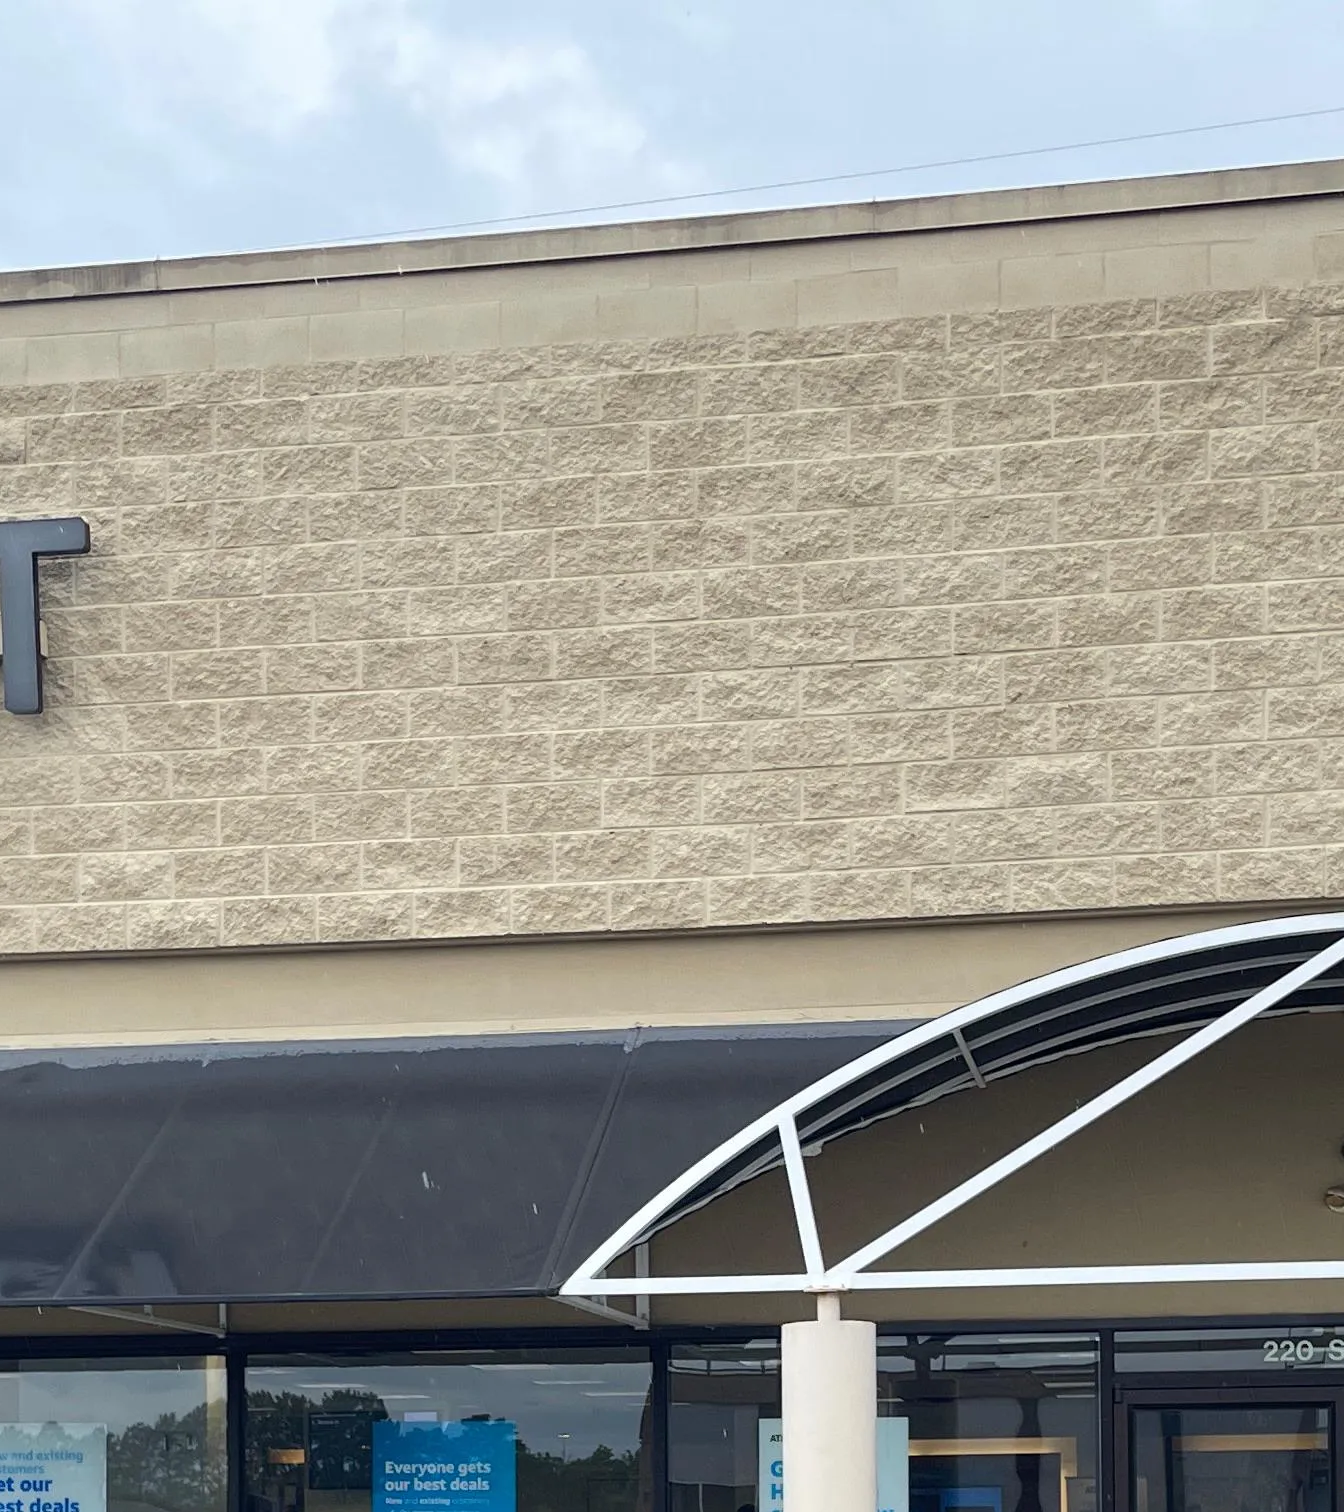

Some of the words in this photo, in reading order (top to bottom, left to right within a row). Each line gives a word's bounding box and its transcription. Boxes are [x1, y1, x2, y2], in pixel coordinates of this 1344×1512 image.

[1263, 1340, 1314, 1362] 220
[770, 1434, 783, 1442] AT
[385, 1461, 454, 1477] Everyone
[458, 1461, 491, 1476] gets
[20, 1480, 53, 1492] our
[385, 1480, 410, 1491] our
[414, 1478, 447, 1491] best
[450, 1478, 489, 1491] deals
